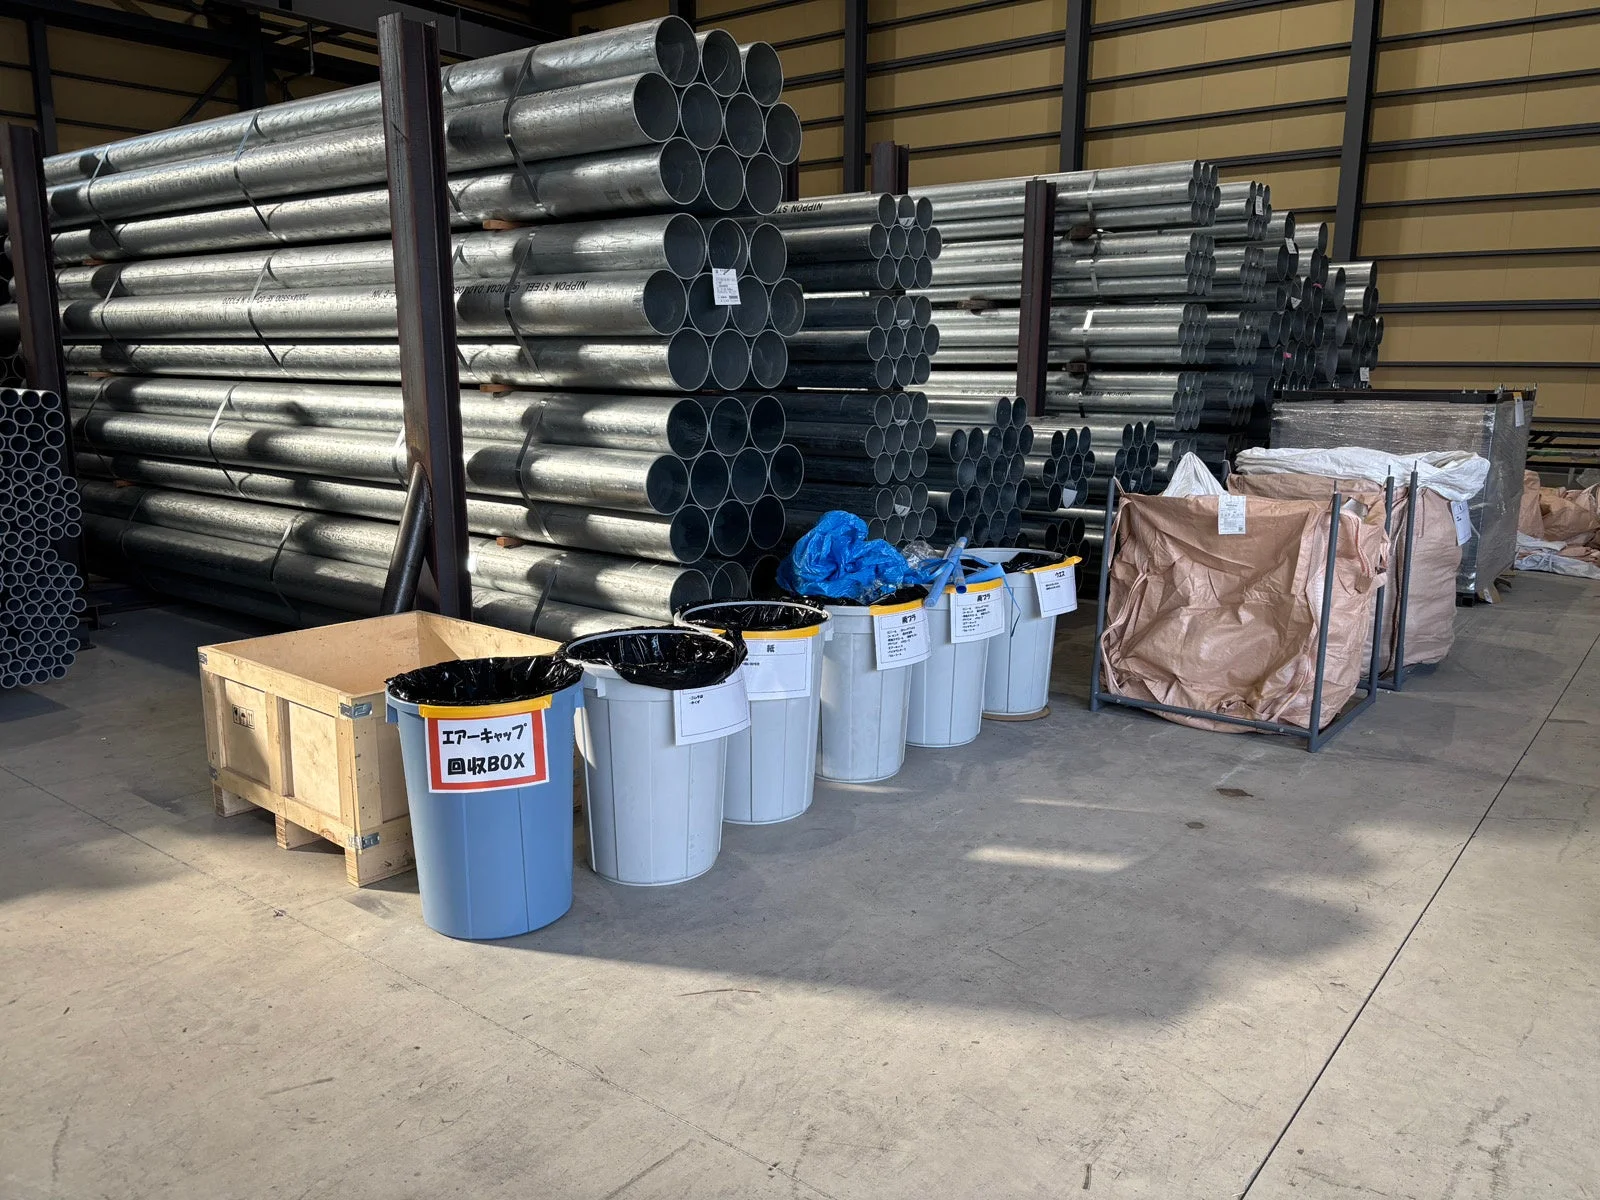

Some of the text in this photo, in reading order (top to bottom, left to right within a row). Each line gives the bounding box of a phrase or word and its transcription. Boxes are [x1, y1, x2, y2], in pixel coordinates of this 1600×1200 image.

[790, 202, 823, 213] NIPPON
[525, 282, 551, 292] STEEL
[553, 280, 588, 292] NIPPON
[442, 722, 528, 745] エアーキャップ
[447, 752, 526, 776] 回収BOX
